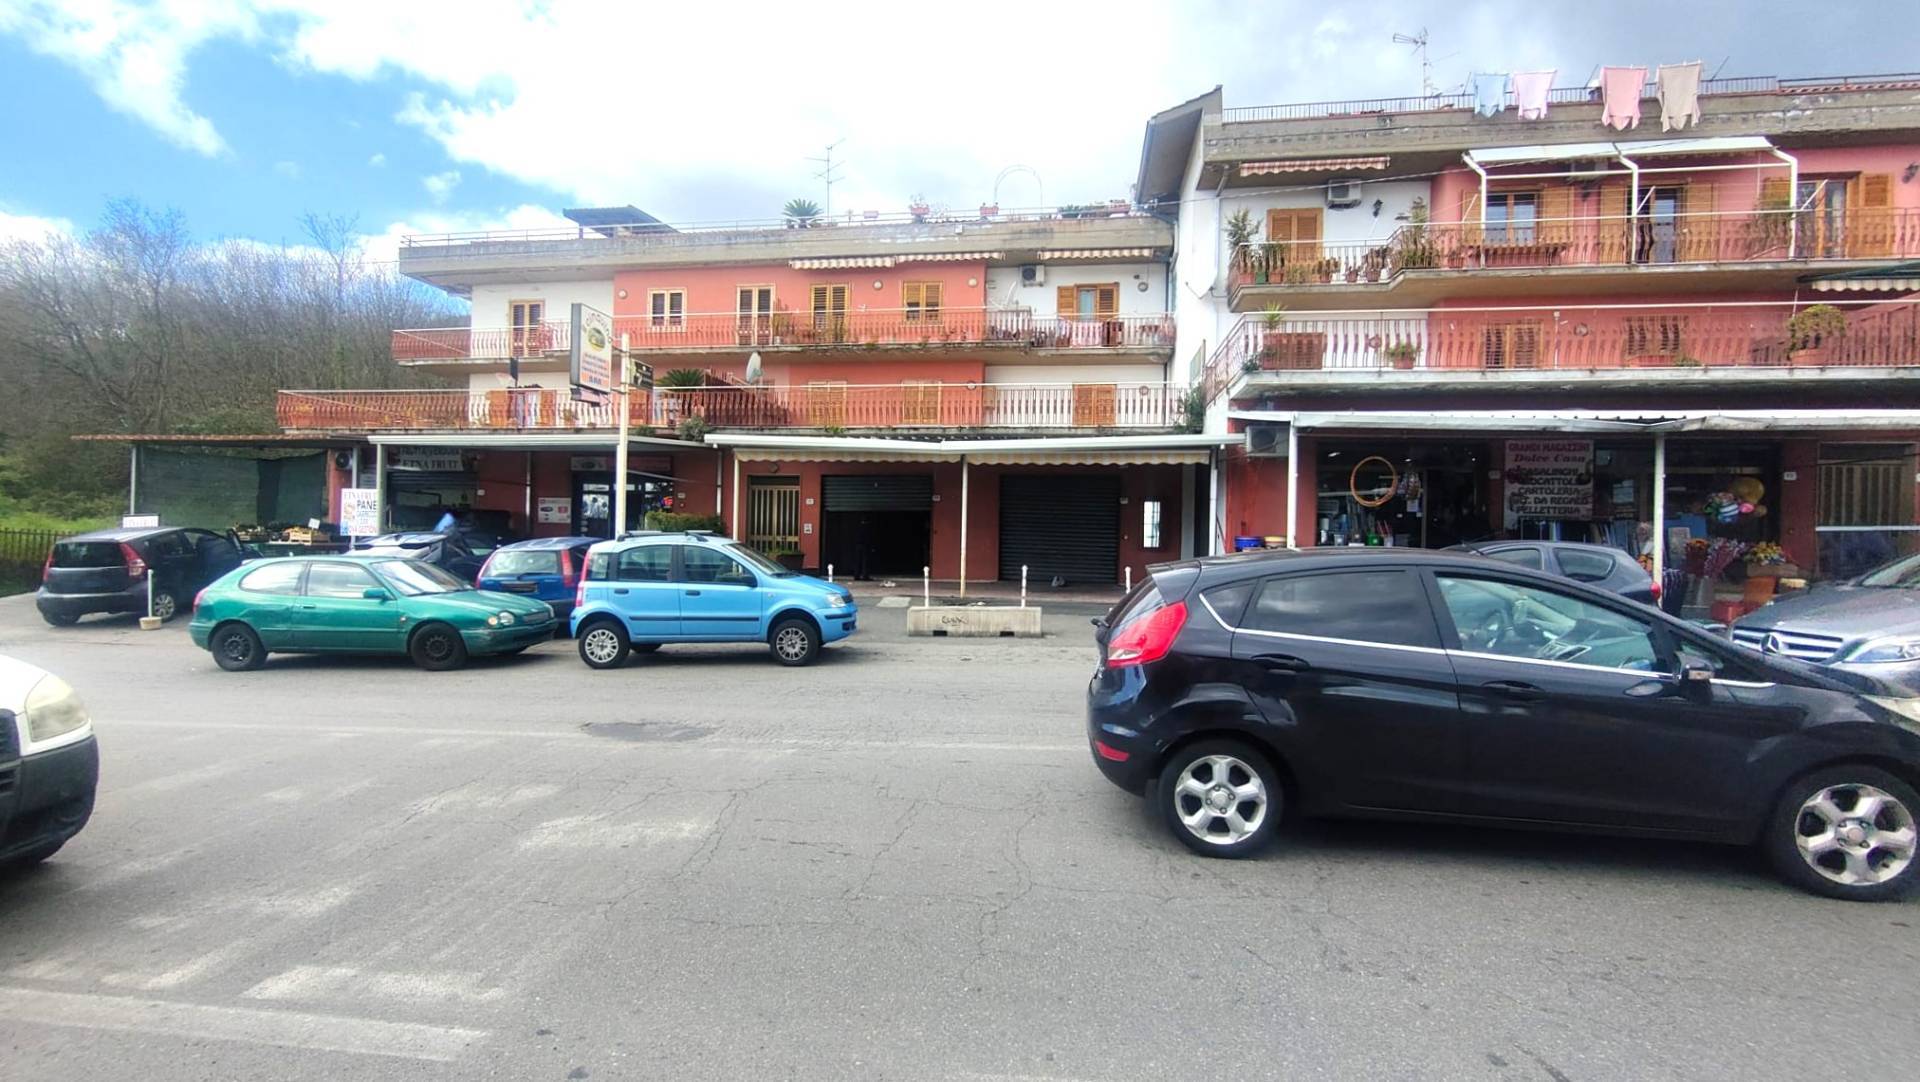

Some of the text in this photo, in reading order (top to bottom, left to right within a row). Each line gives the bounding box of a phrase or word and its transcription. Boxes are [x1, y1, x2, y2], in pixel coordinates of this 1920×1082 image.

[1514, 453, 1550, 462] Dolce
[1518, 487, 1581, 496] CARTOLERIA
[357, 500, 377, 510] PANE
[1534, 496, 1548, 505] DA
